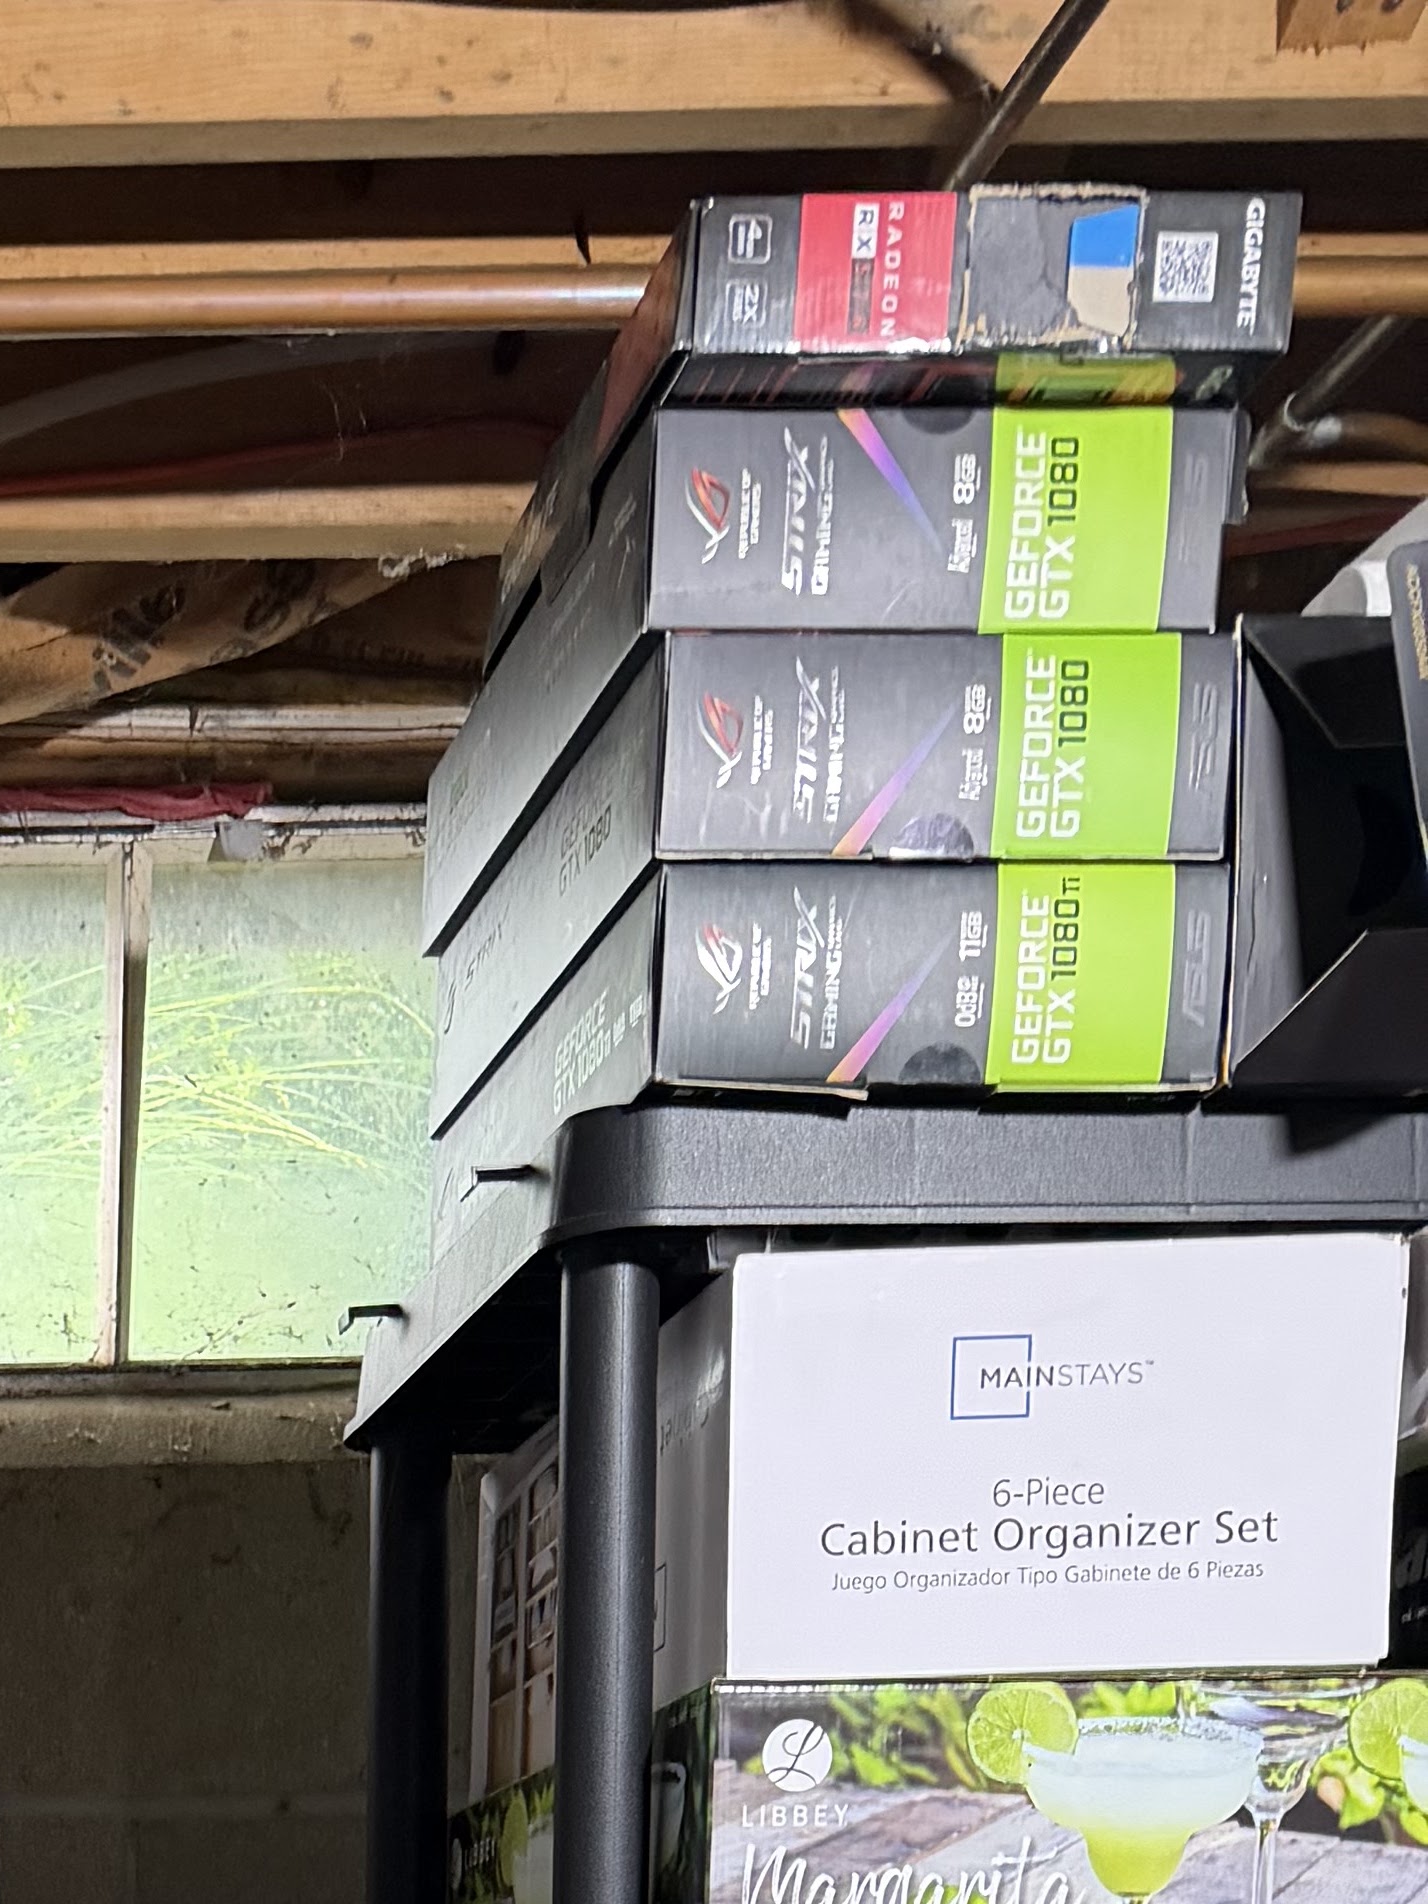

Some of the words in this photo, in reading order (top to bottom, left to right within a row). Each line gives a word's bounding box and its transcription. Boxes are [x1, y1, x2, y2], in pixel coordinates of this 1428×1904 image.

[856, 206, 875, 256] RX
[881, 200, 905, 338] RADEON
[1236, 196, 1265, 336] GIGABYTE
[782, 427, 815, 596] STRIX
[953, 452, 981, 505] 8GB
[1005, 424, 1048, 619] GEFORCE
[1048, 436, 1080, 528] 1080
[1038, 535, 1076, 619] GTX
[793, 656, 826, 823] STRIX
[963, 684, 991, 736] 8GB
[1016, 648, 1058, 838] GEFORCE
[1058, 658, 1090, 749] 1080
[1050, 755, 1087, 839] GTX
[559, 853, 583, 897] GTX
[583, 803, 612, 866] 1080
[790, 886, 825, 1050] STRIX
[958, 911, 989, 963] 11GB
[1011, 887, 1051, 1065] GEFORCE
[554, 987, 608, 1080] GEFORCE
[1042, 986, 1076, 1065] GTX
[553, 1069, 577, 1116] GTX
[820, 1519, 979, 1557] Cabinet
[993, 1513, 1201, 1560] Organizer
[1214, 1510, 1279, 1545] Set
[992, 1477, 1106, 1508] 6-Piece
[831, 1573, 887, 1594] Juego
[893, 1569, 1011, 1593] Organizador
[1017, 1567, 1058, 1588] Tipo
[1064, 1563, 1152, 1585] Gabinete
[1157, 1561, 1182, 1581] de
[1187, 1560, 1201, 1581] 6
[1206, 1559, 1265, 1580] Piezas
[742, 1804, 850, 1828] LIBBEY
